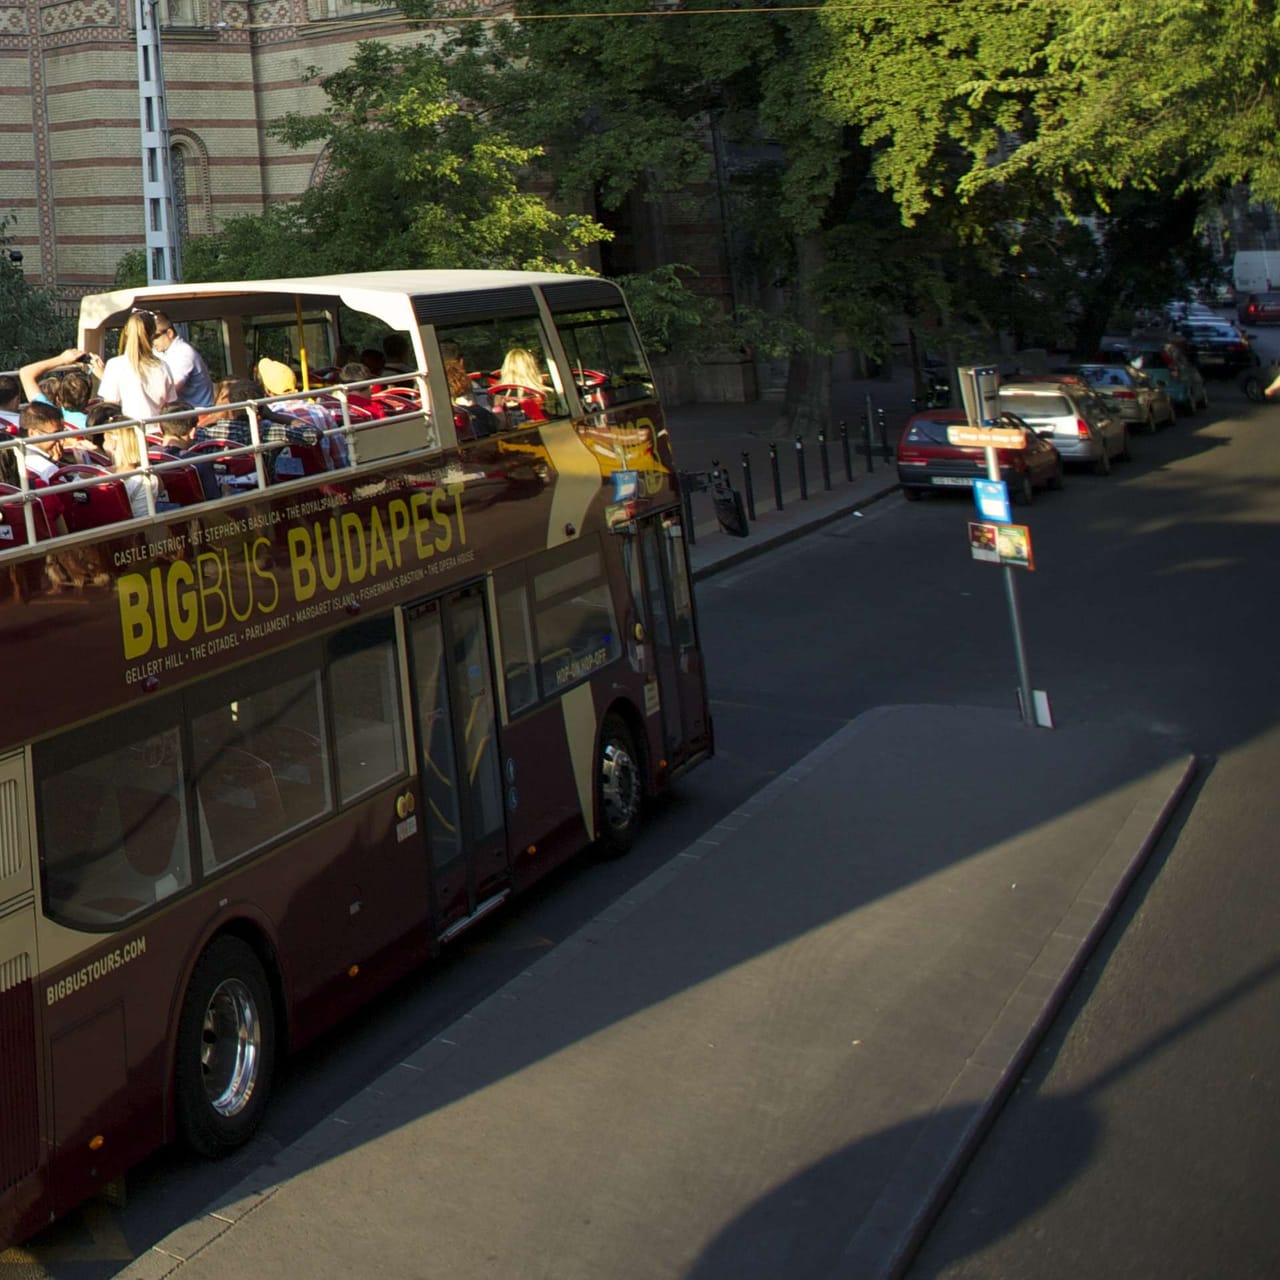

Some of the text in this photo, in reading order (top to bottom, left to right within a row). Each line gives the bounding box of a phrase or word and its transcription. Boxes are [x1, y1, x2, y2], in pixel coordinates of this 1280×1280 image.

[114, 545, 147, 566] CASTLE
[149, 535, 186, 557] DISTRICT
[193, 531, 203, 545] ST
[205, 519, 248, 542] STEPHEN'S
[248, 510, 281, 530] BASILICA
[286, 505, 301, 518] THE
[288, 482, 466, 602] BUDAPEST
[126, 550, 475, 684] GELLERT HILL THE CITADEL PARLIAMENT MARGARET ISLAND FISHERMAN'S BASTION THE OPERA HOUSE
[46, 936, 146, 1006] BIGBUSTOURS.COM
